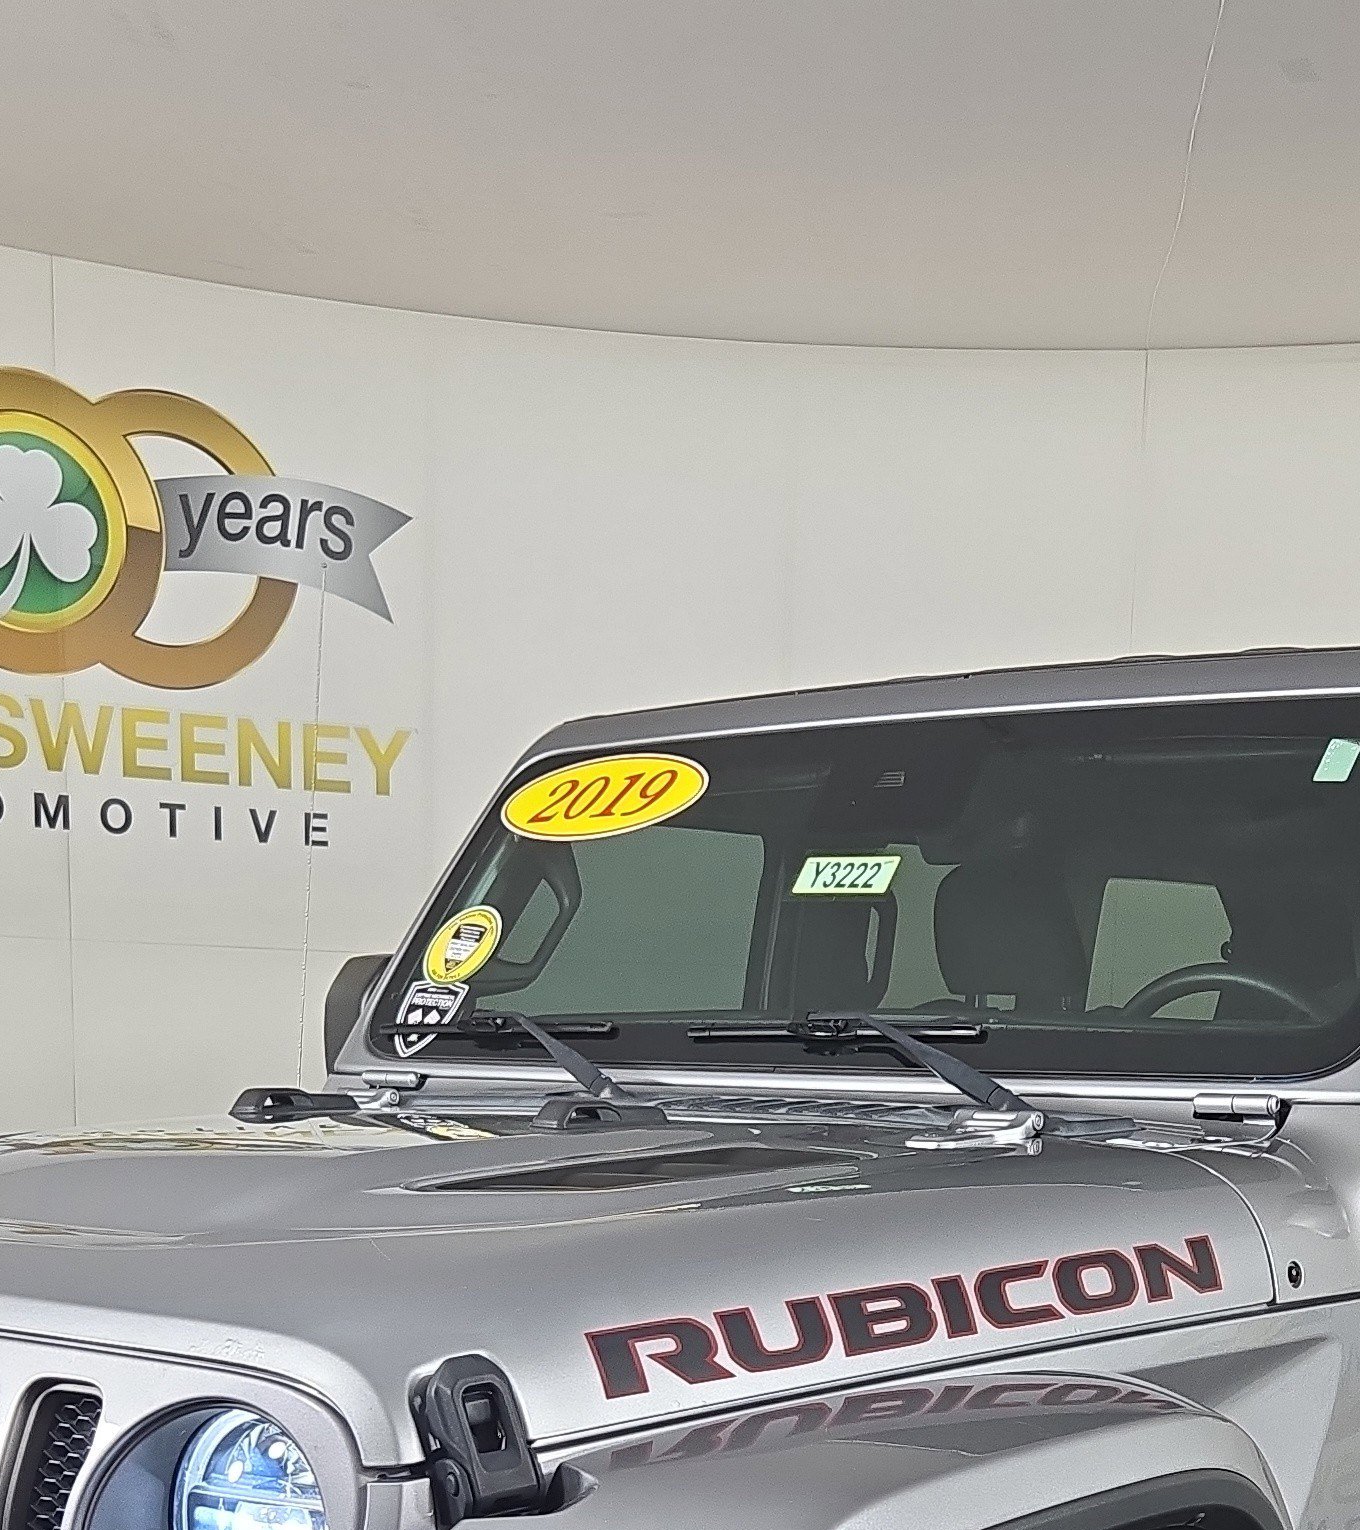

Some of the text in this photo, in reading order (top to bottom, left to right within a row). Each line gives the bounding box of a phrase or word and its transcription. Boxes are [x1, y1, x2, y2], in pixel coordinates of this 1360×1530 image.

[178, 489, 356, 562] years
[527, 768, 679, 826] 2019
[809, 861, 883, 889] Y3222
[584, 1234, 1223, 1400] RUBICON
